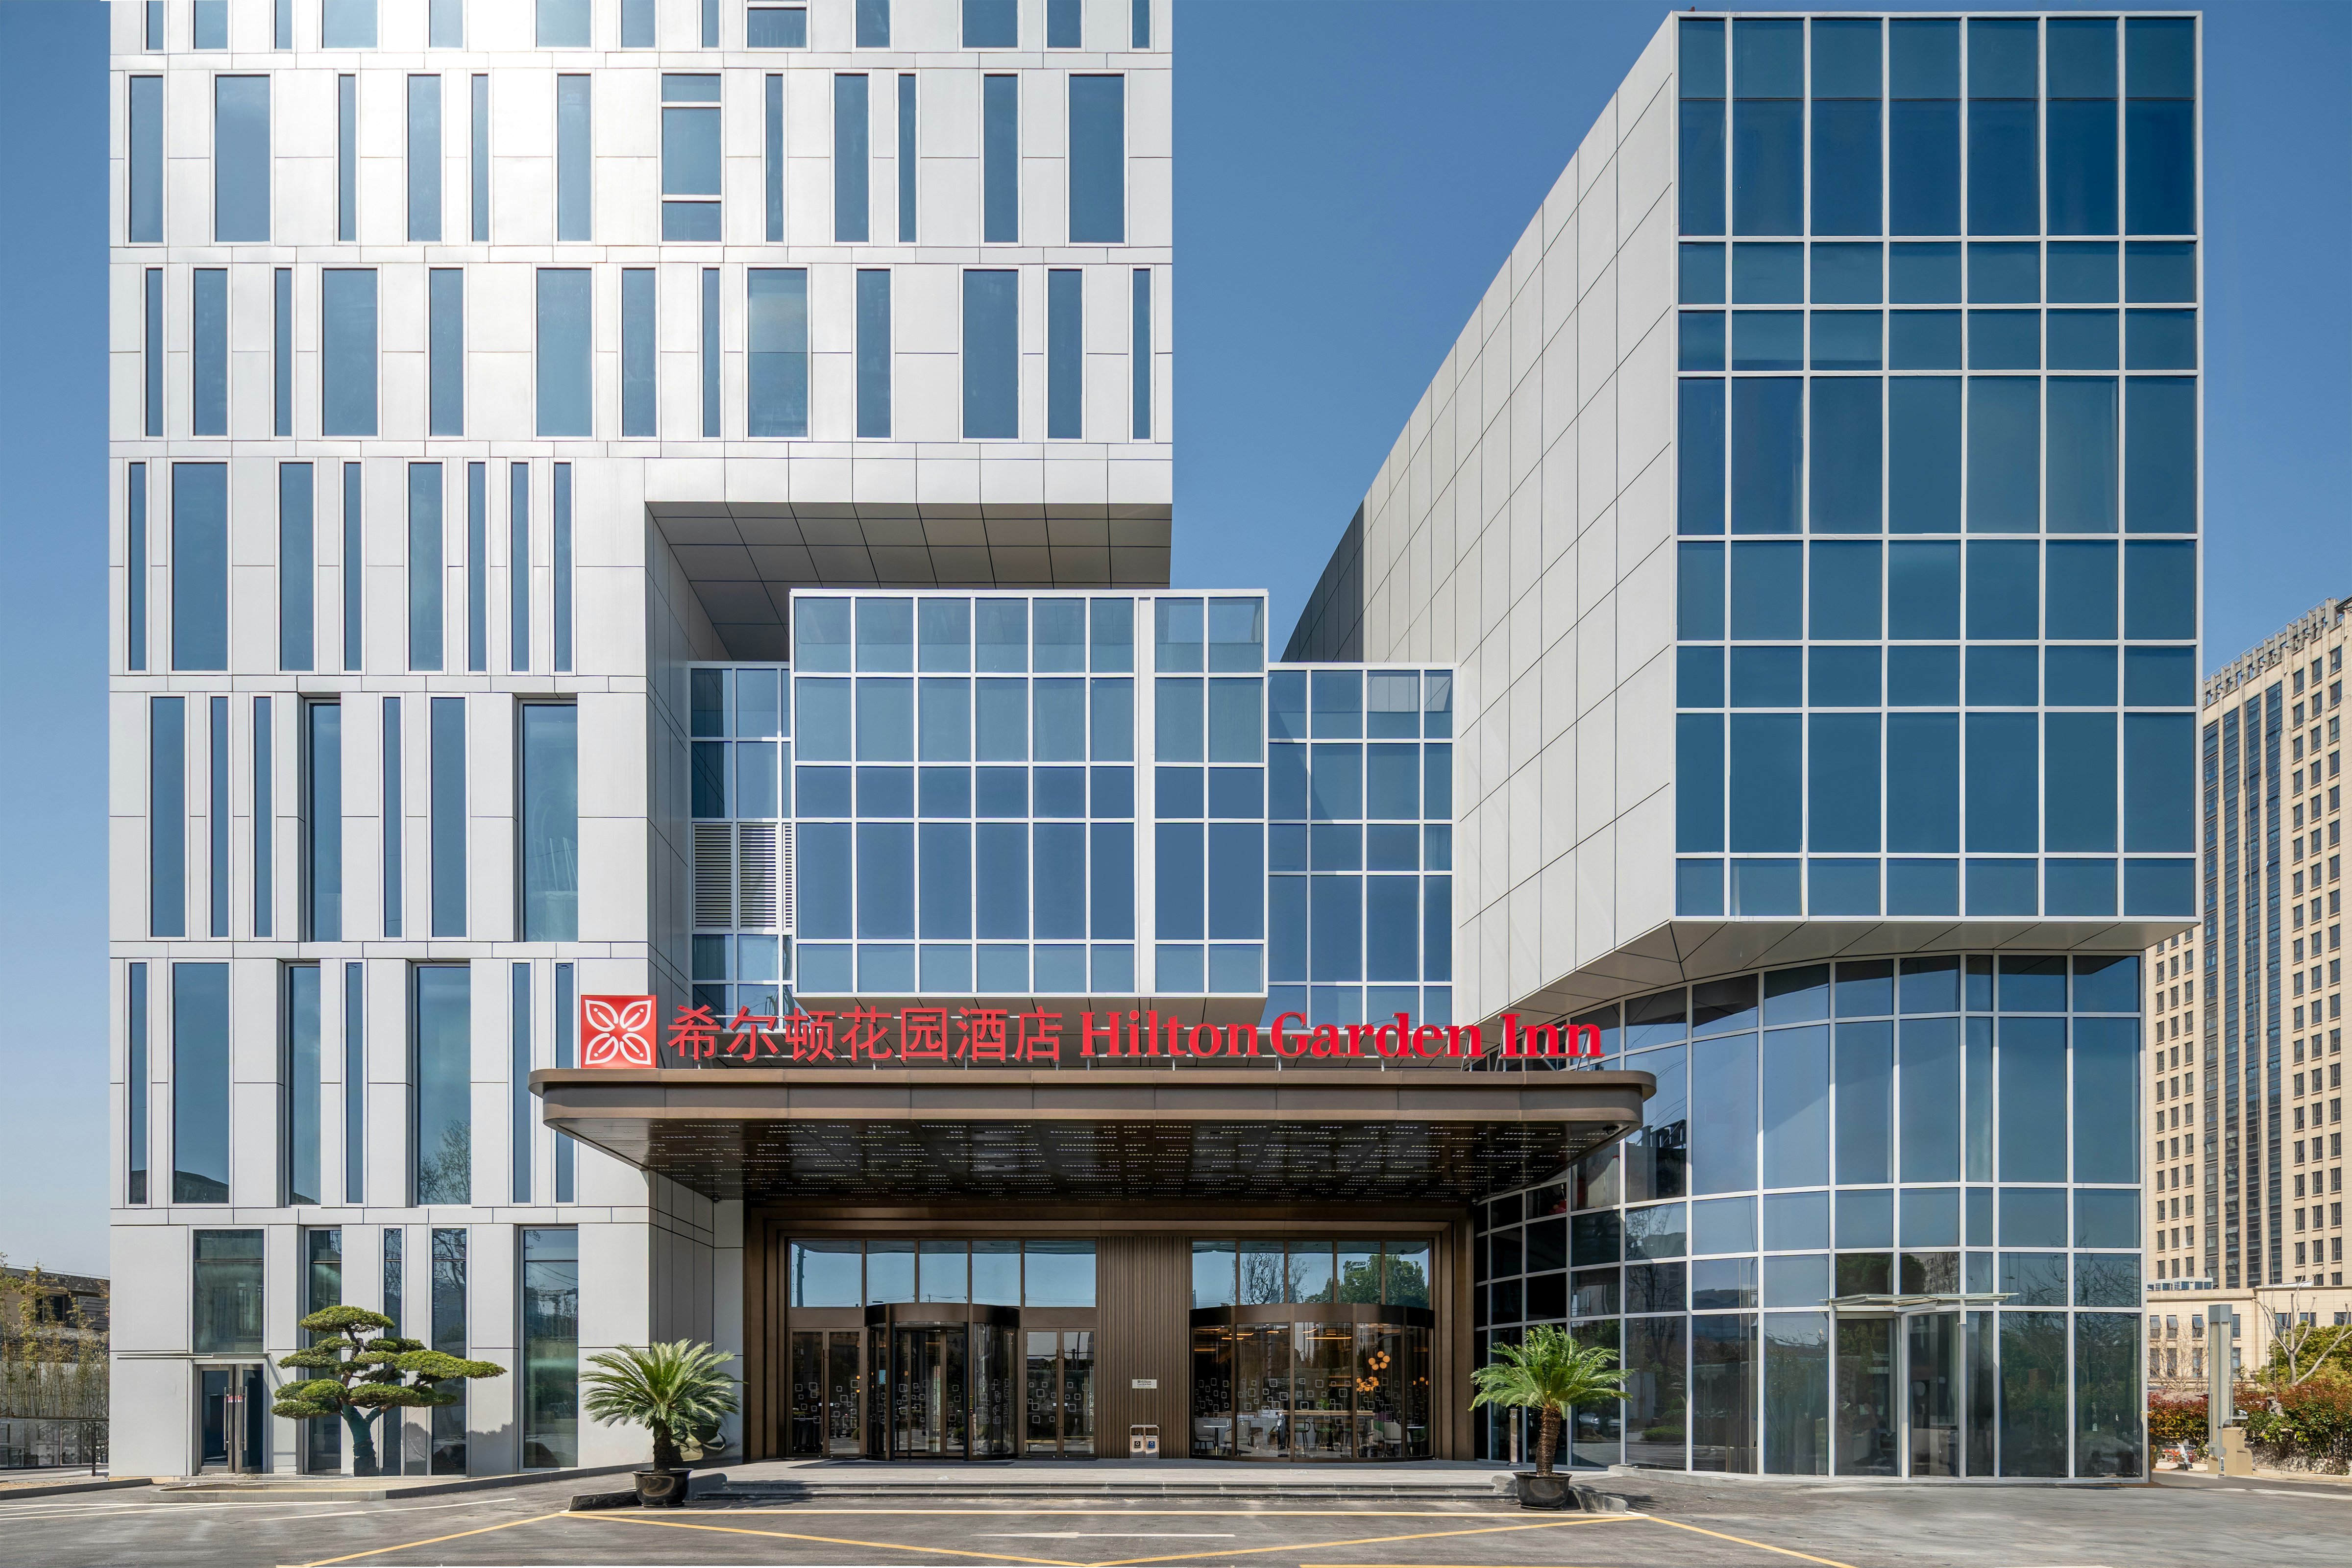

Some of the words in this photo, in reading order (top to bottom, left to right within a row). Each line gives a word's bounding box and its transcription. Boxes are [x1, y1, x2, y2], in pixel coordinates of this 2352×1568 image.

[667, 1004, 1063, 1062] 希尔顿花园酒店
[1079, 1010, 1260, 1057] Hilton
[1270, 1012, 1486, 1058] Garden
[1499, 1013, 1605, 1057] Inn
